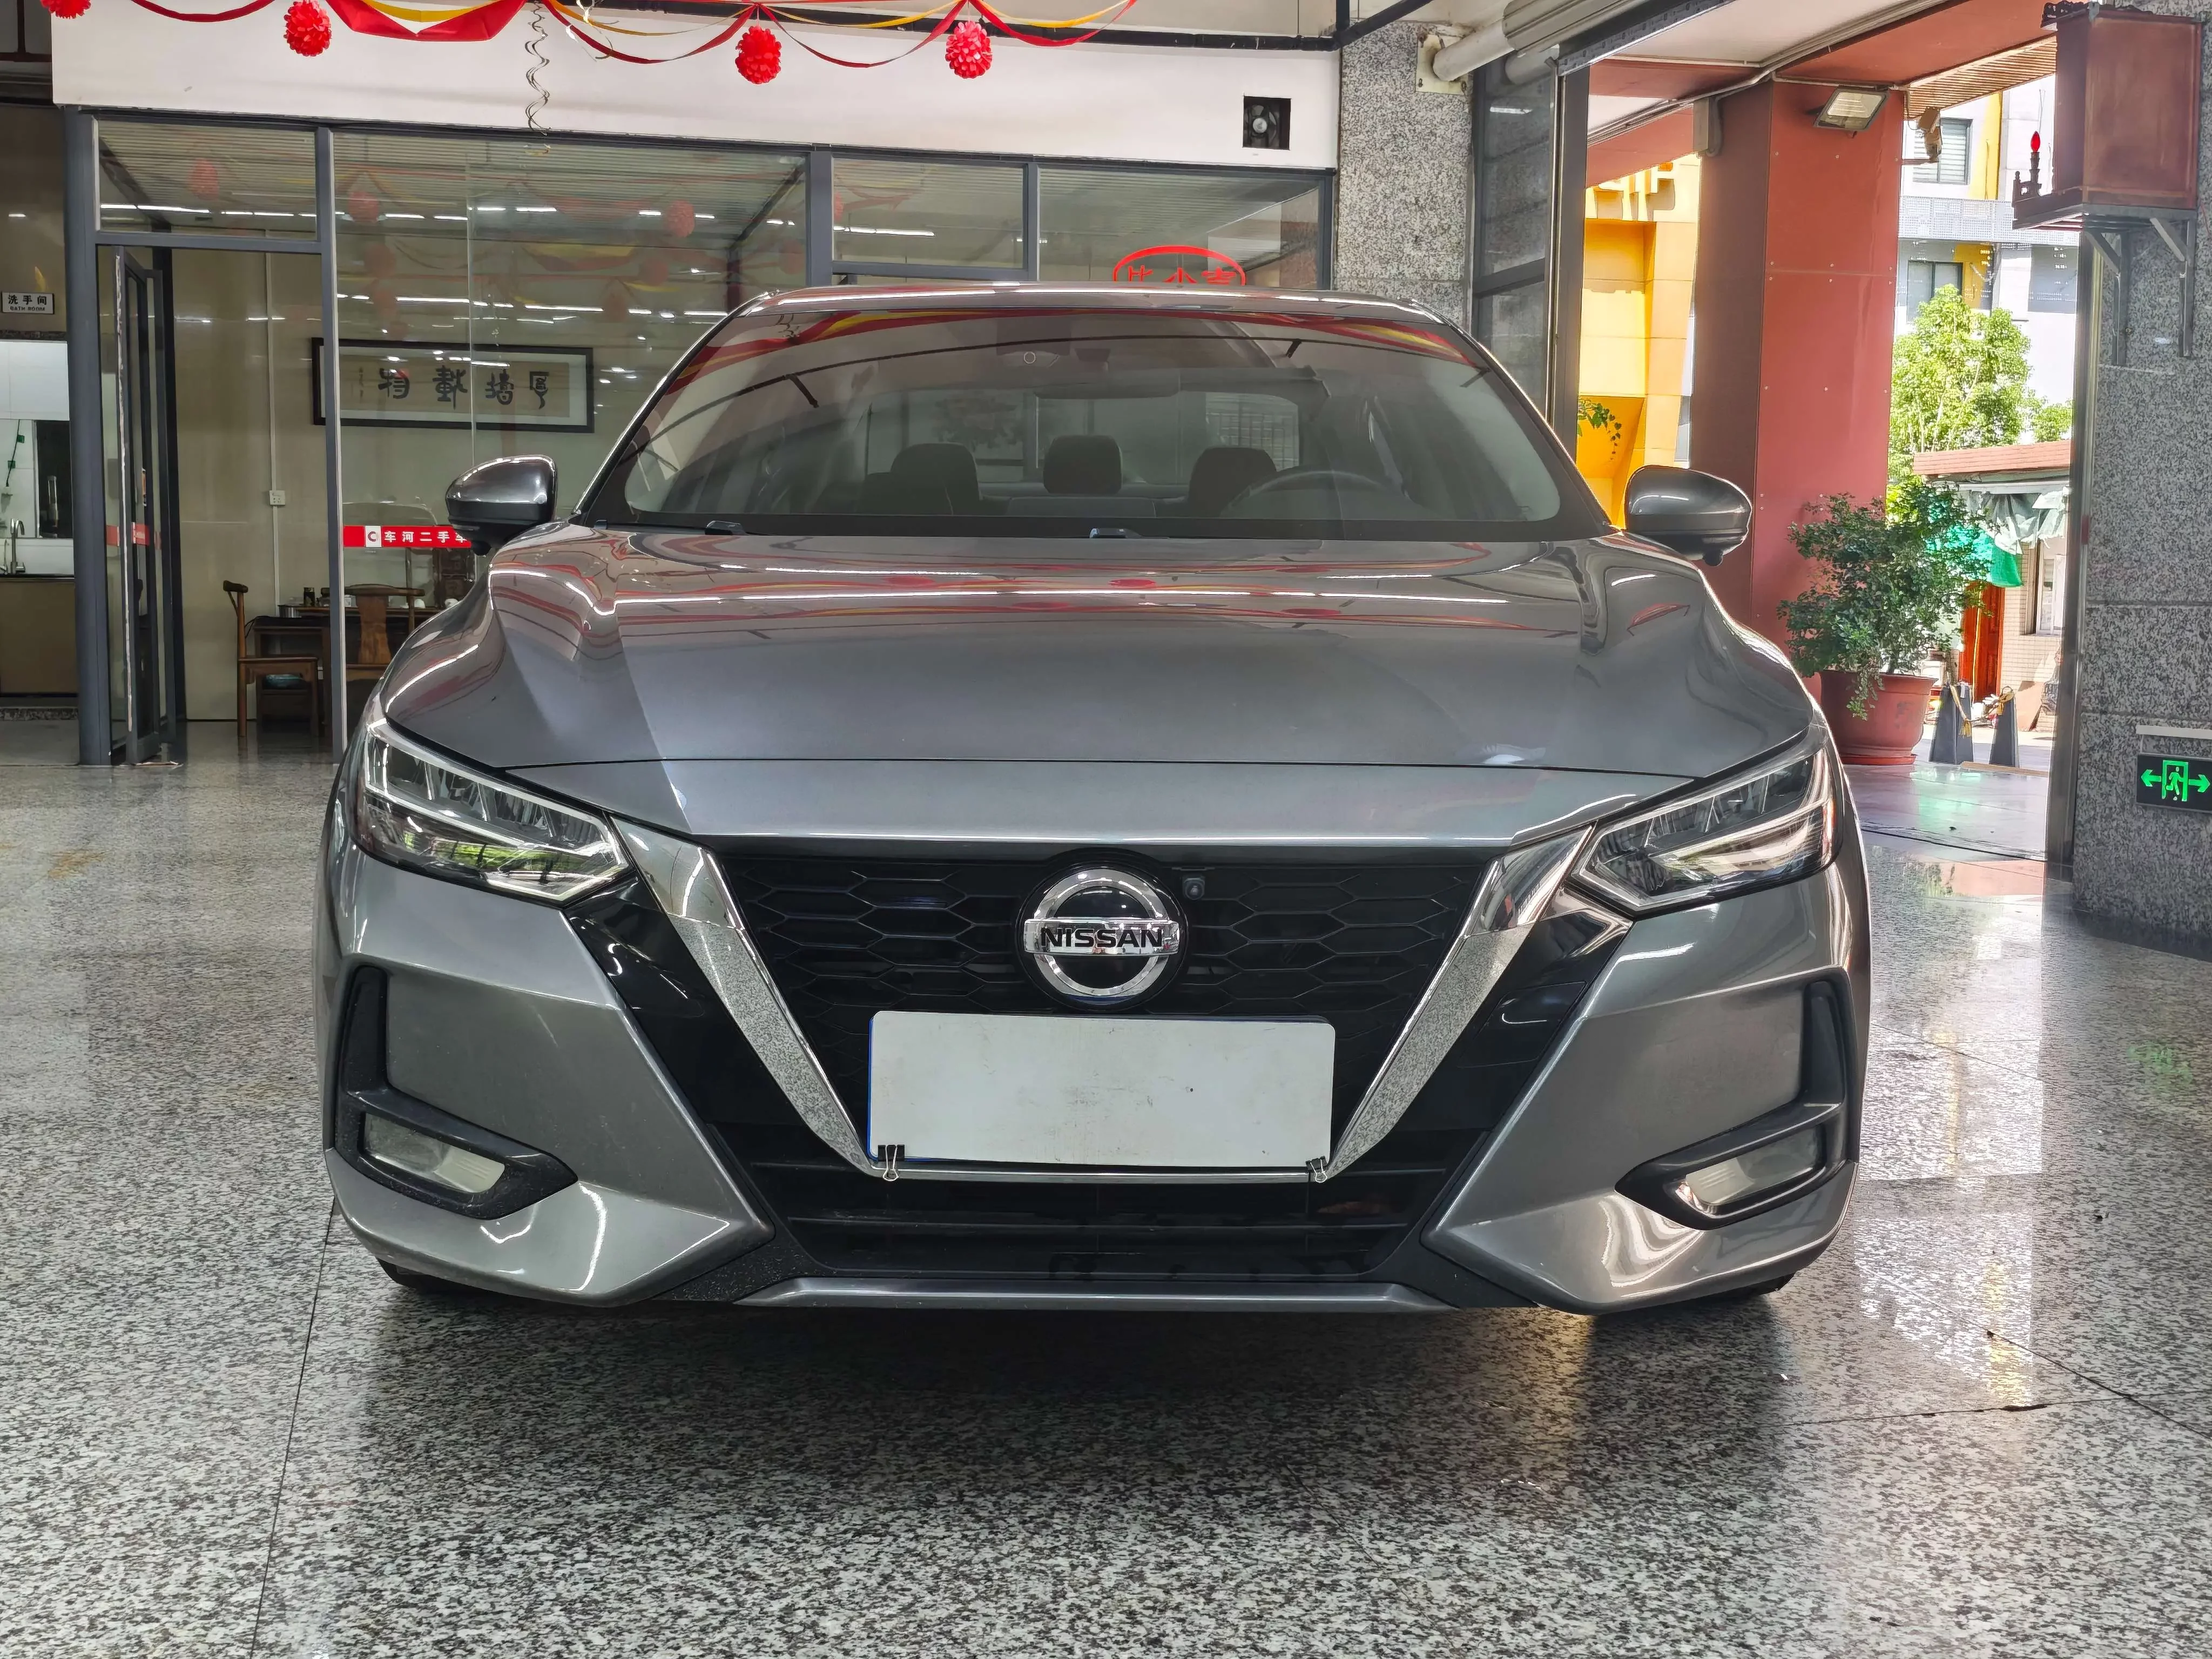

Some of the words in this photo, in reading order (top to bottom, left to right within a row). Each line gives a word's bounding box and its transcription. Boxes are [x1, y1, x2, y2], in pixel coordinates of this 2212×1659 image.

[8, 294, 47, 305] 洗手间
[1041, 927, 1163, 948] NISSAN
